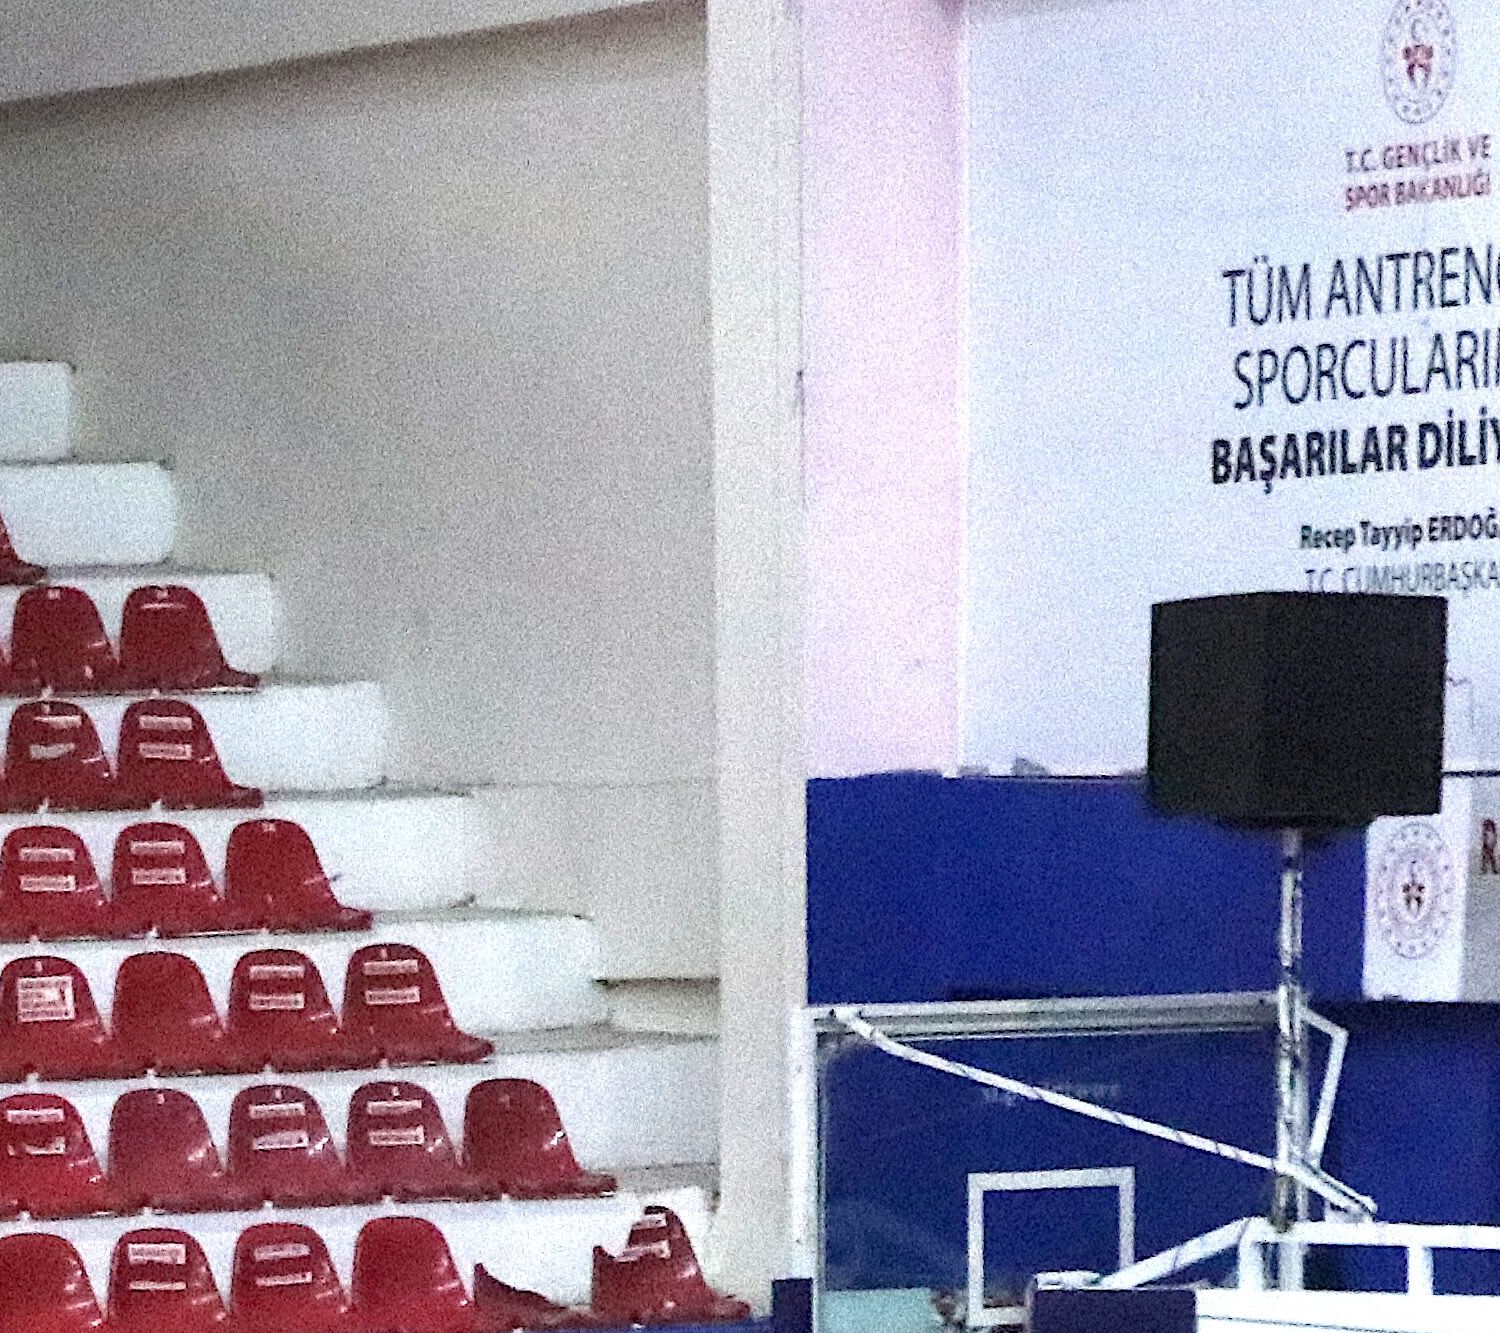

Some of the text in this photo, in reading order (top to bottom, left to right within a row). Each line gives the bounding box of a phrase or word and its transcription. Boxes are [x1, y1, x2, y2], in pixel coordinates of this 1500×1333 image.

[1468, 133, 1492, 160] VE
[1345, 182, 1390, 212] SPOR
[1222, 255, 1312, 327] TÜM
[1211, 424, 1409, 494] BAŞARILAR
[1300, 524, 1356, 554] Recep
[1360, 518, 1423, 552] Tayyip
